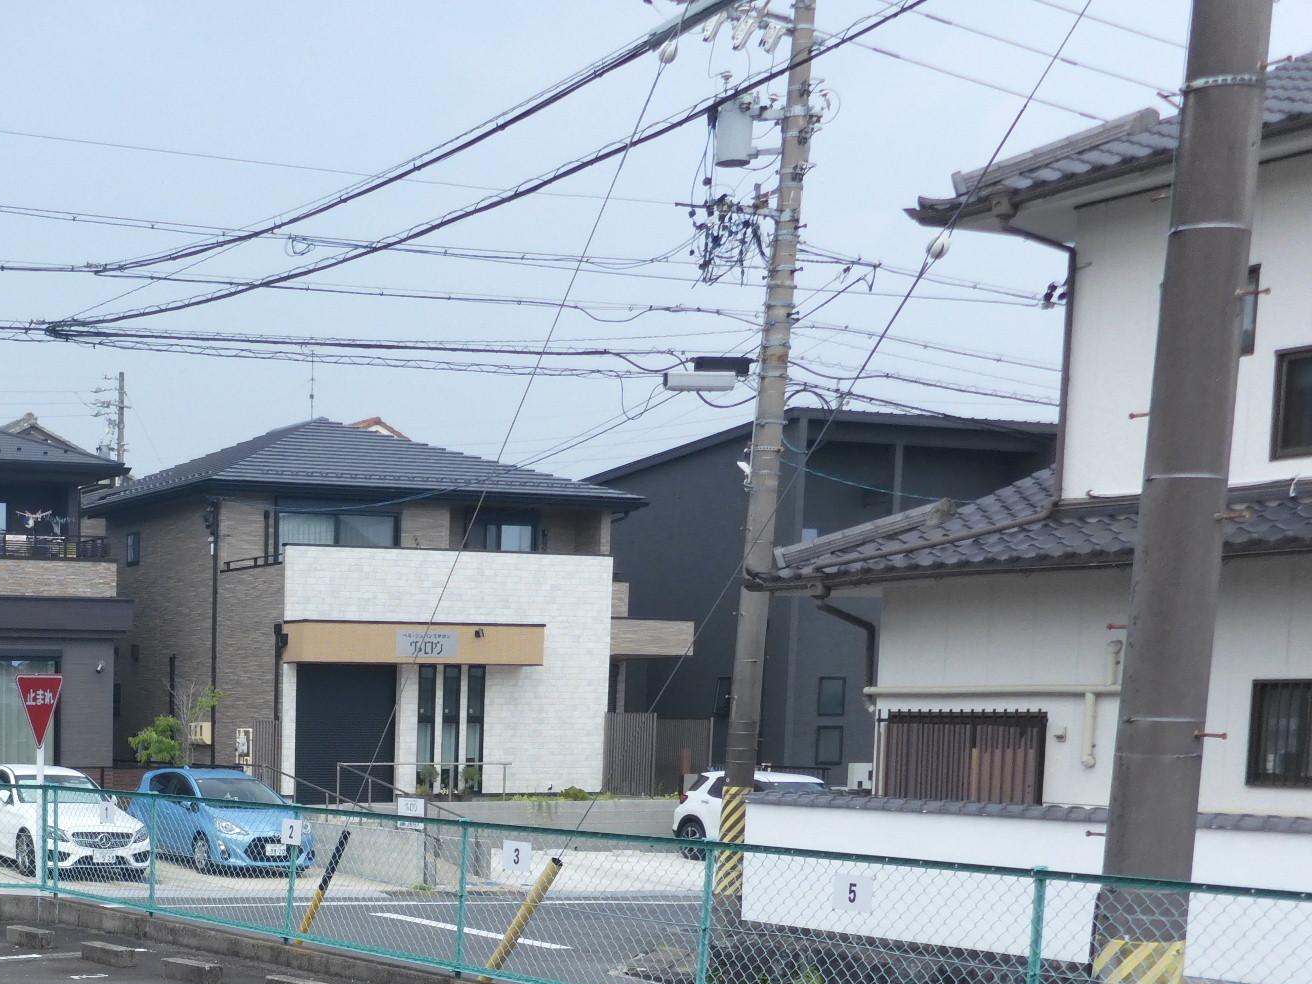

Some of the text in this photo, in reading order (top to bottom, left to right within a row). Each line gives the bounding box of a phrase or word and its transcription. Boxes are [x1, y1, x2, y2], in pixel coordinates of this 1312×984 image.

[26, 688, 54, 706] 止まれ
[288, 825, 294, 839] 2
[513, 848, 520, 865] 3
[848, 883, 857, 903] 5
